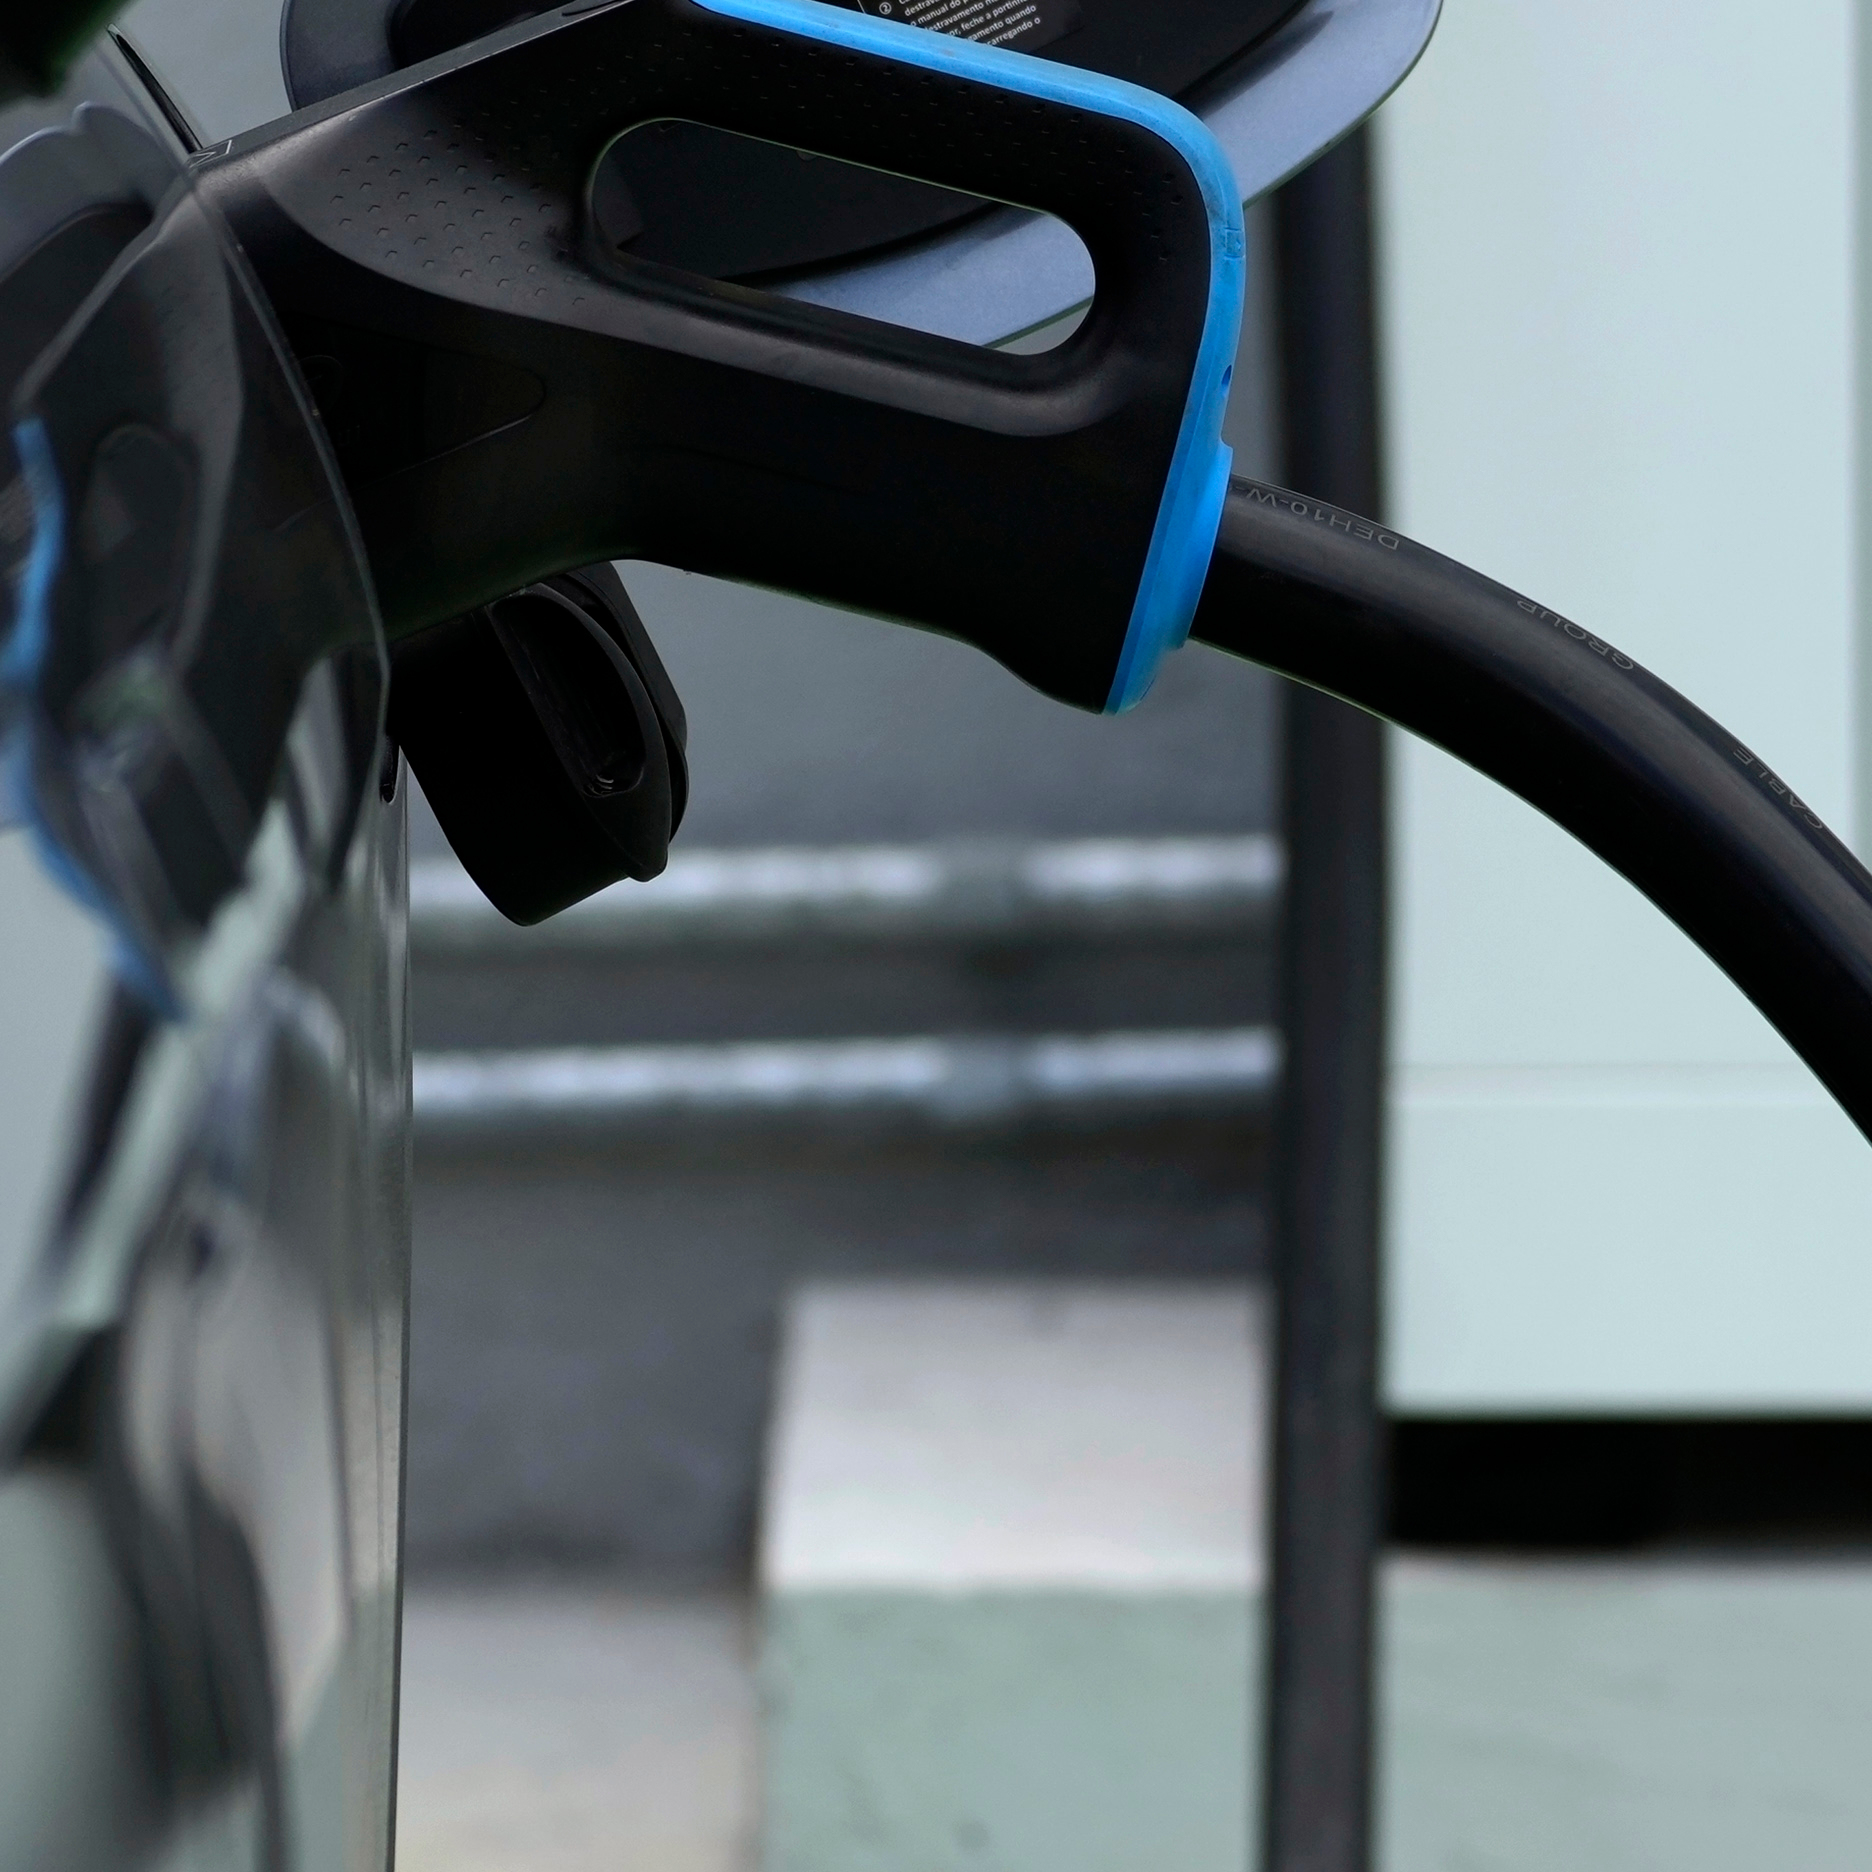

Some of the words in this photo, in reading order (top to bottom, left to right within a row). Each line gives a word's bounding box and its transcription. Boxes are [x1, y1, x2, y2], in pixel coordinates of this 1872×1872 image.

[917, 3, 949, 24] manual
[949, 0, 962, 9] do
[960, 16, 984, 31] feche
[985, 12, 992, 20] a
[1004, 4, 1037, 25] quando
[1033, 17, 1041, 25] o
[1228, 482, 1400, 552] DEH10-W-
[1516, 597, 1636, 671] GROUP
[1733, 746, 1824, 830] CABLE
